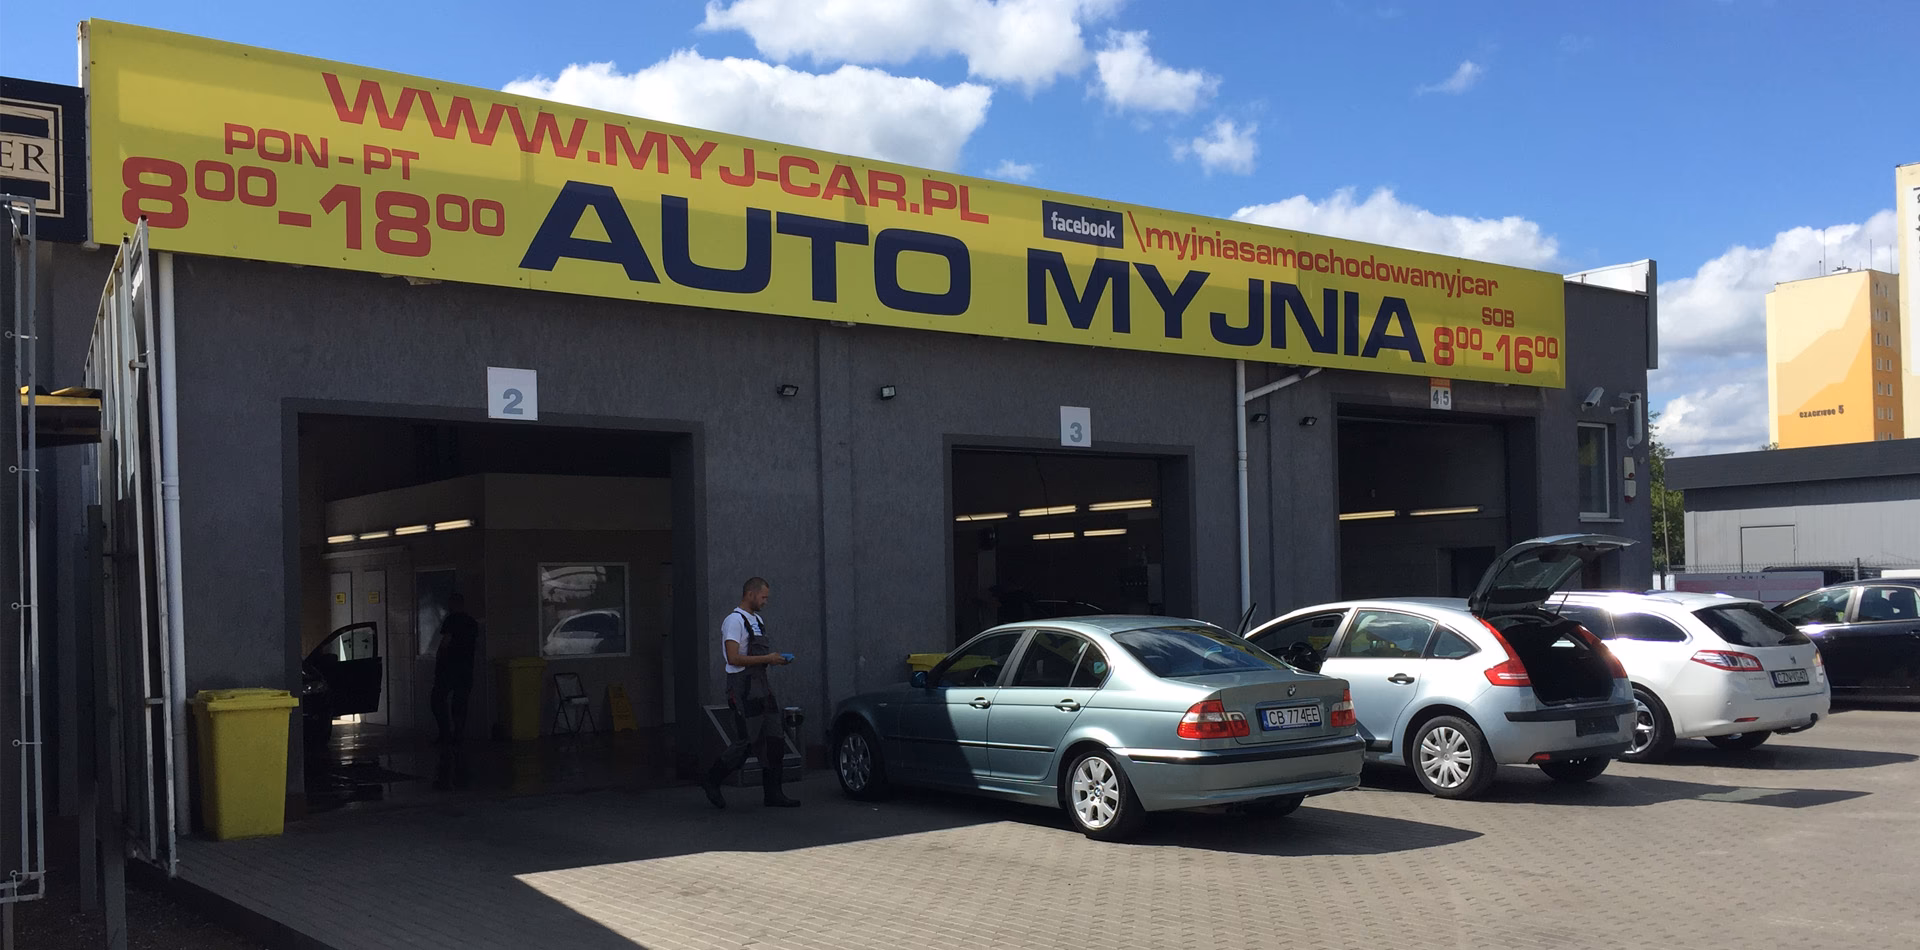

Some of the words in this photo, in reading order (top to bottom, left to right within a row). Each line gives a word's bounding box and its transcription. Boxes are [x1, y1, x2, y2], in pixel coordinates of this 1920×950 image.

[224, 123, 328, 169] PON
[363, 145, 419, 181] PT
[322, 73, 989, 225] WWW.MYJ-CAR.PL
[1051, 211, 1116, 239] facebook
[519, 180, 971, 315] AUTO
[1027, 247, 1426, 364] MYJNIA
[1481, 307, 1515, 328] SOB
[503, 388, 523, 415] 2
[1838, 404, 1845, 414] 5
[1070, 422, 1083, 442] 3
[1269, 710, 1285, 725] CB
[1287, 707, 1319, 723] 774EE
